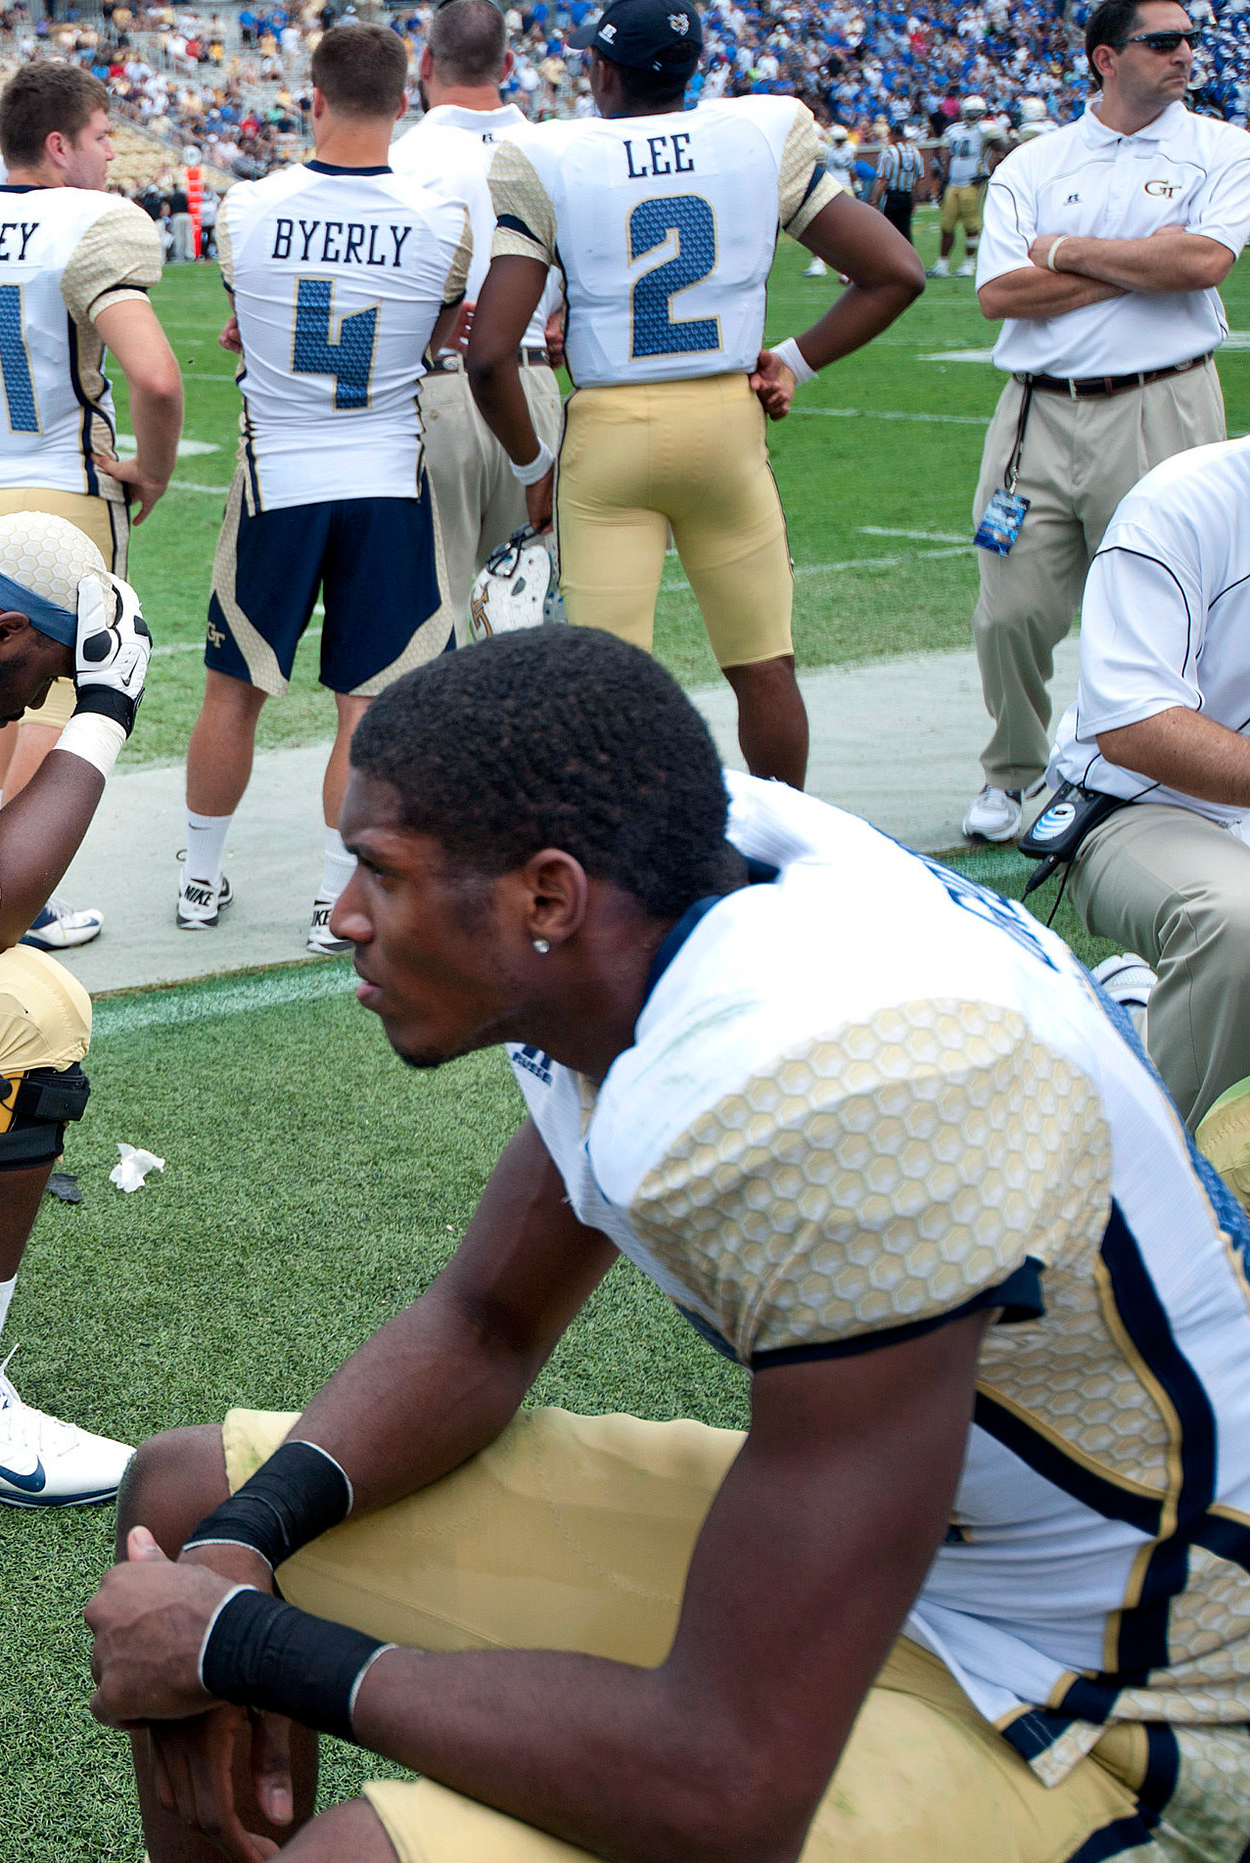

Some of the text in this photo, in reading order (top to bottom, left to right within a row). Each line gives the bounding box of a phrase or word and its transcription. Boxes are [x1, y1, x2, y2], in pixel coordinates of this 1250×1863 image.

[623, 133, 695, 178] LEE
[1144, 180, 1182, 199] GT
[272, 219, 412, 267] BYERLY
[626, 192, 724, 361] 2
[291, 276, 382, 411] 4
[184, 885, 215, 907] NIKE
[311, 909, 331, 927] IKE
